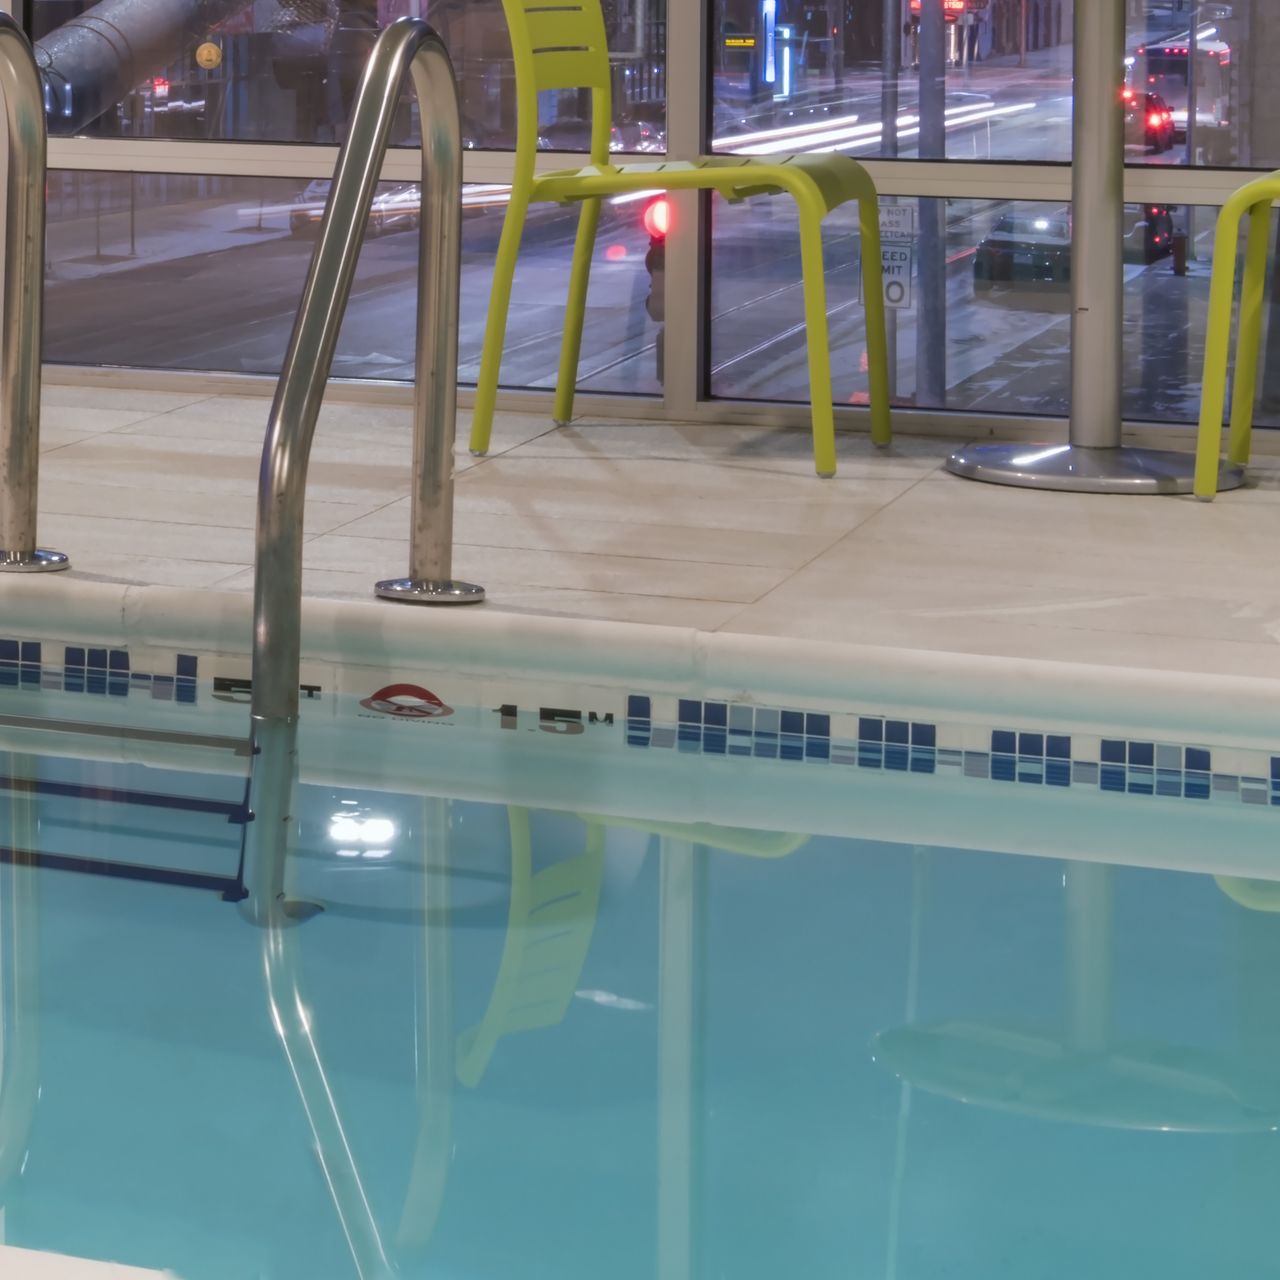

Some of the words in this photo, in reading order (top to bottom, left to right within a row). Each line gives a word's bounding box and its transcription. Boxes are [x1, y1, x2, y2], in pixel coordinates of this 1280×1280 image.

[887, 208, 908, 217] NOT
[881, 220, 901, 228] ASS
[882, 251, 907, 262] EED
[881, 265, 904, 276] MIT
[885, 281, 905, 304] 0
